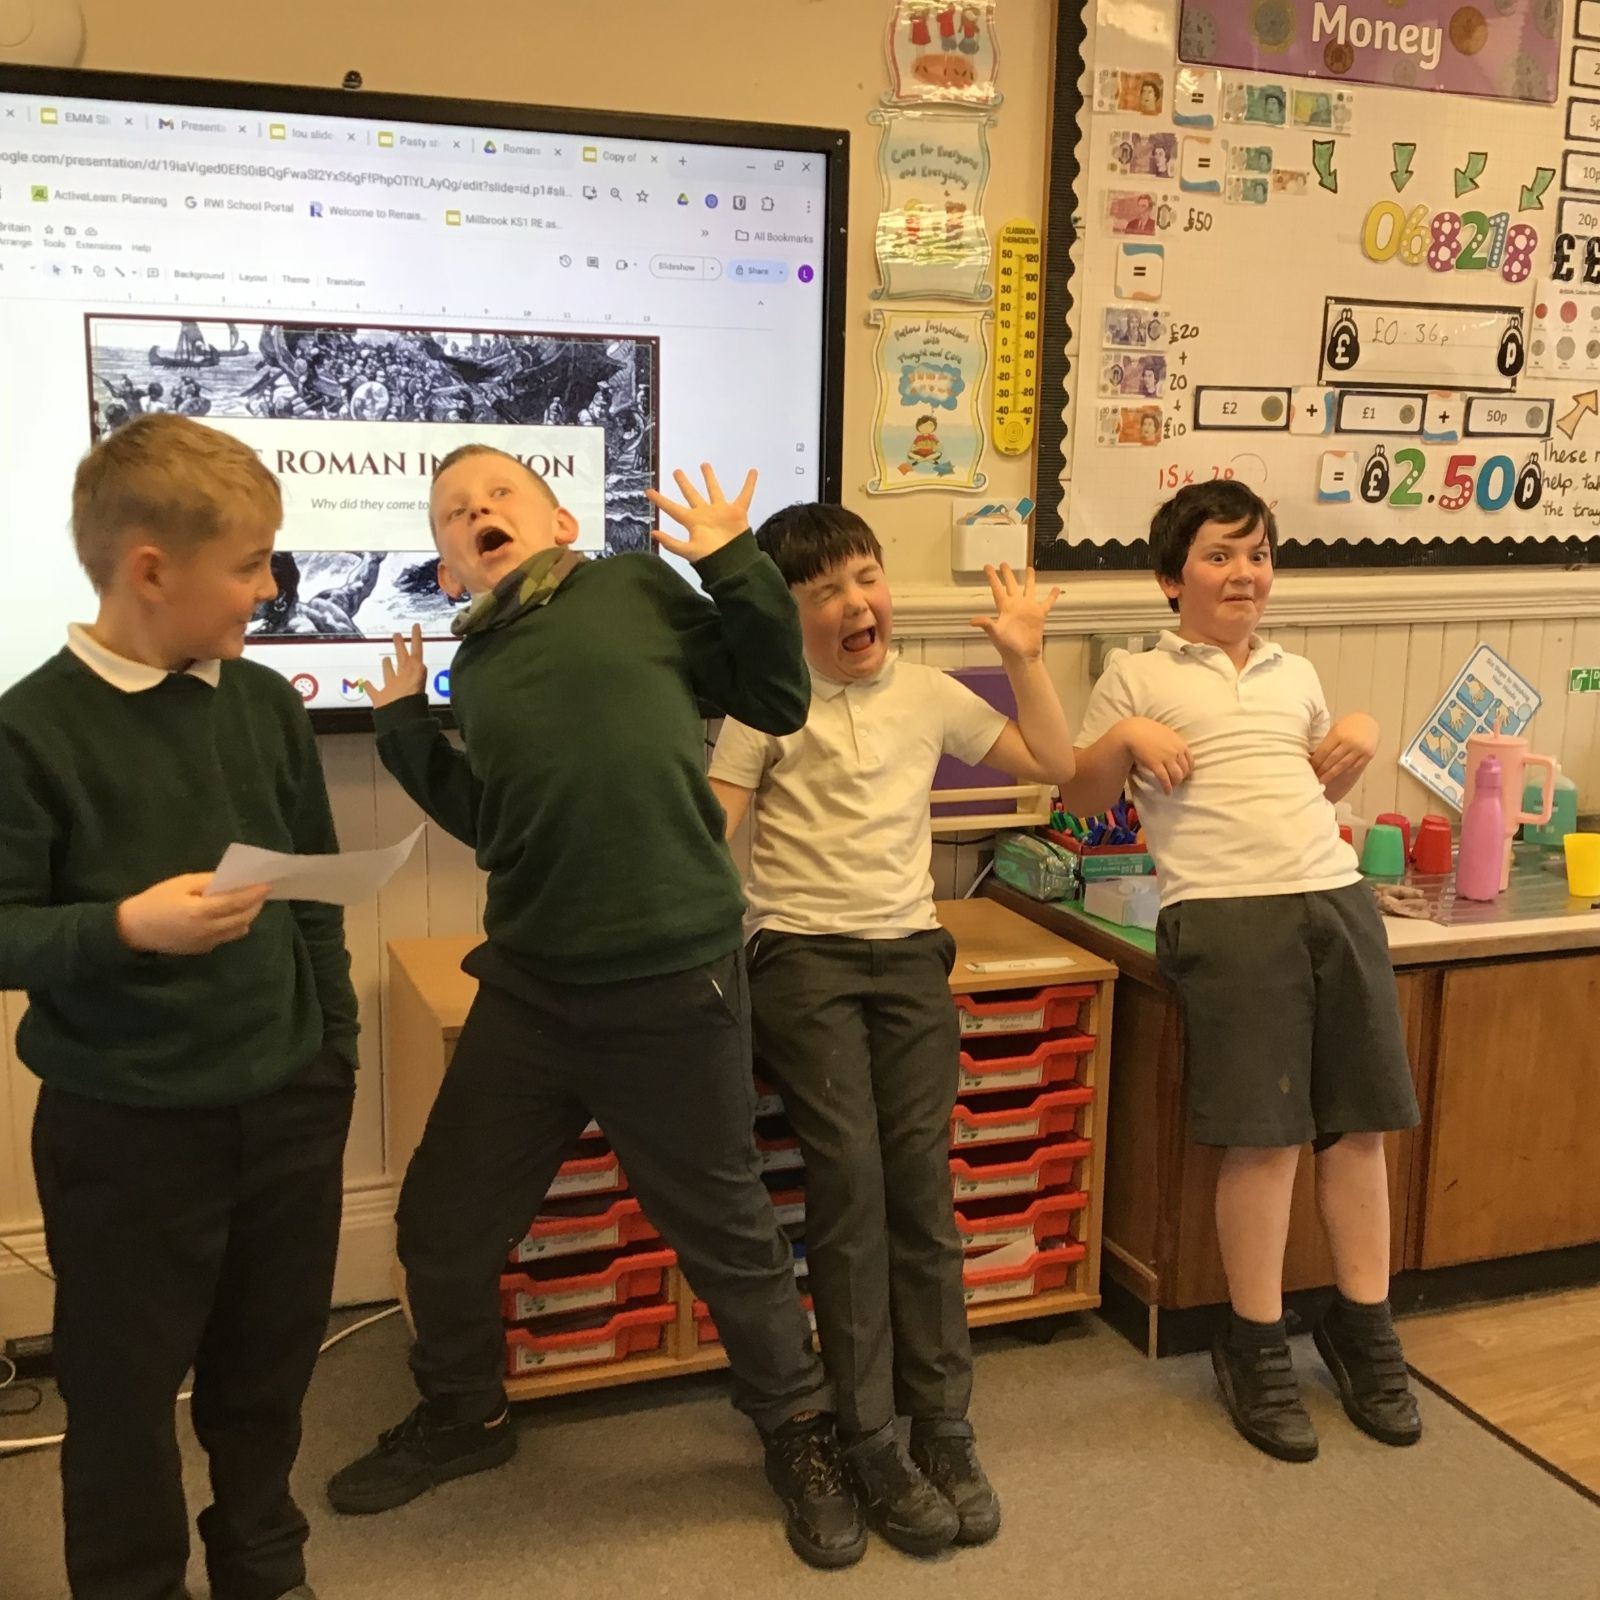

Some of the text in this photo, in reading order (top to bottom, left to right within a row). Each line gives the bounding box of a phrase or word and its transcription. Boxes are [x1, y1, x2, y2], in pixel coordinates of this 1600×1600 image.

[1311, 2, 1443, 71] Money
[602, 150, 637, 166] Copy of
[891, 149, 916, 164] Care
[920, 143, 934, 156] for
[899, 167, 917, 179] and
[122, 193, 168, 208] Planning
[227, 199, 262, 212] School
[264, 200, 295, 213] Portal
[329, 206, 374, 219] Welcome
[376, 208, 386, 219] to
[1183, 208, 1213, 232] £50
[466, 213, 508, 227] Millbrook
[510, 216, 528, 228] KS1
[530, 218, 543, 229] RE
[1578, 214, 1598, 231] 20p
[43, 239, 66, 249] Tools
[76, 240, 122, 251] Extensions
[753, 231, 814, 244] All Bookmarks
[1001, 249, 1039, 263] 50 120
[173, 269, 366, 288] Background Layout Theme Transition
[748, 266, 769, 276] Share
[1001, 267, 1039, 282] 40 100
[1000, 284, 1012, 294] 30
[1000, 303, 1036, 321] 20 60
[1000, 320, 1036, 340] 10 40
[1168, 323, 1200, 345] £20
[1023, 350, 1035, 359] 20
[1169, 373, 1188, 391] 20
[1221, 401, 1238, 415] £2
[1361, 406, 1376, 420] £1
[1486, 409, 1508, 426] 50p
[1163, 417, 1187, 440] £10
[1540, 437, 1588, 464] These
[275, 449, 407, 477] ROMAN
[310, 498, 430, 512] Why did they come to
[1542, 500, 1564, 517] the
